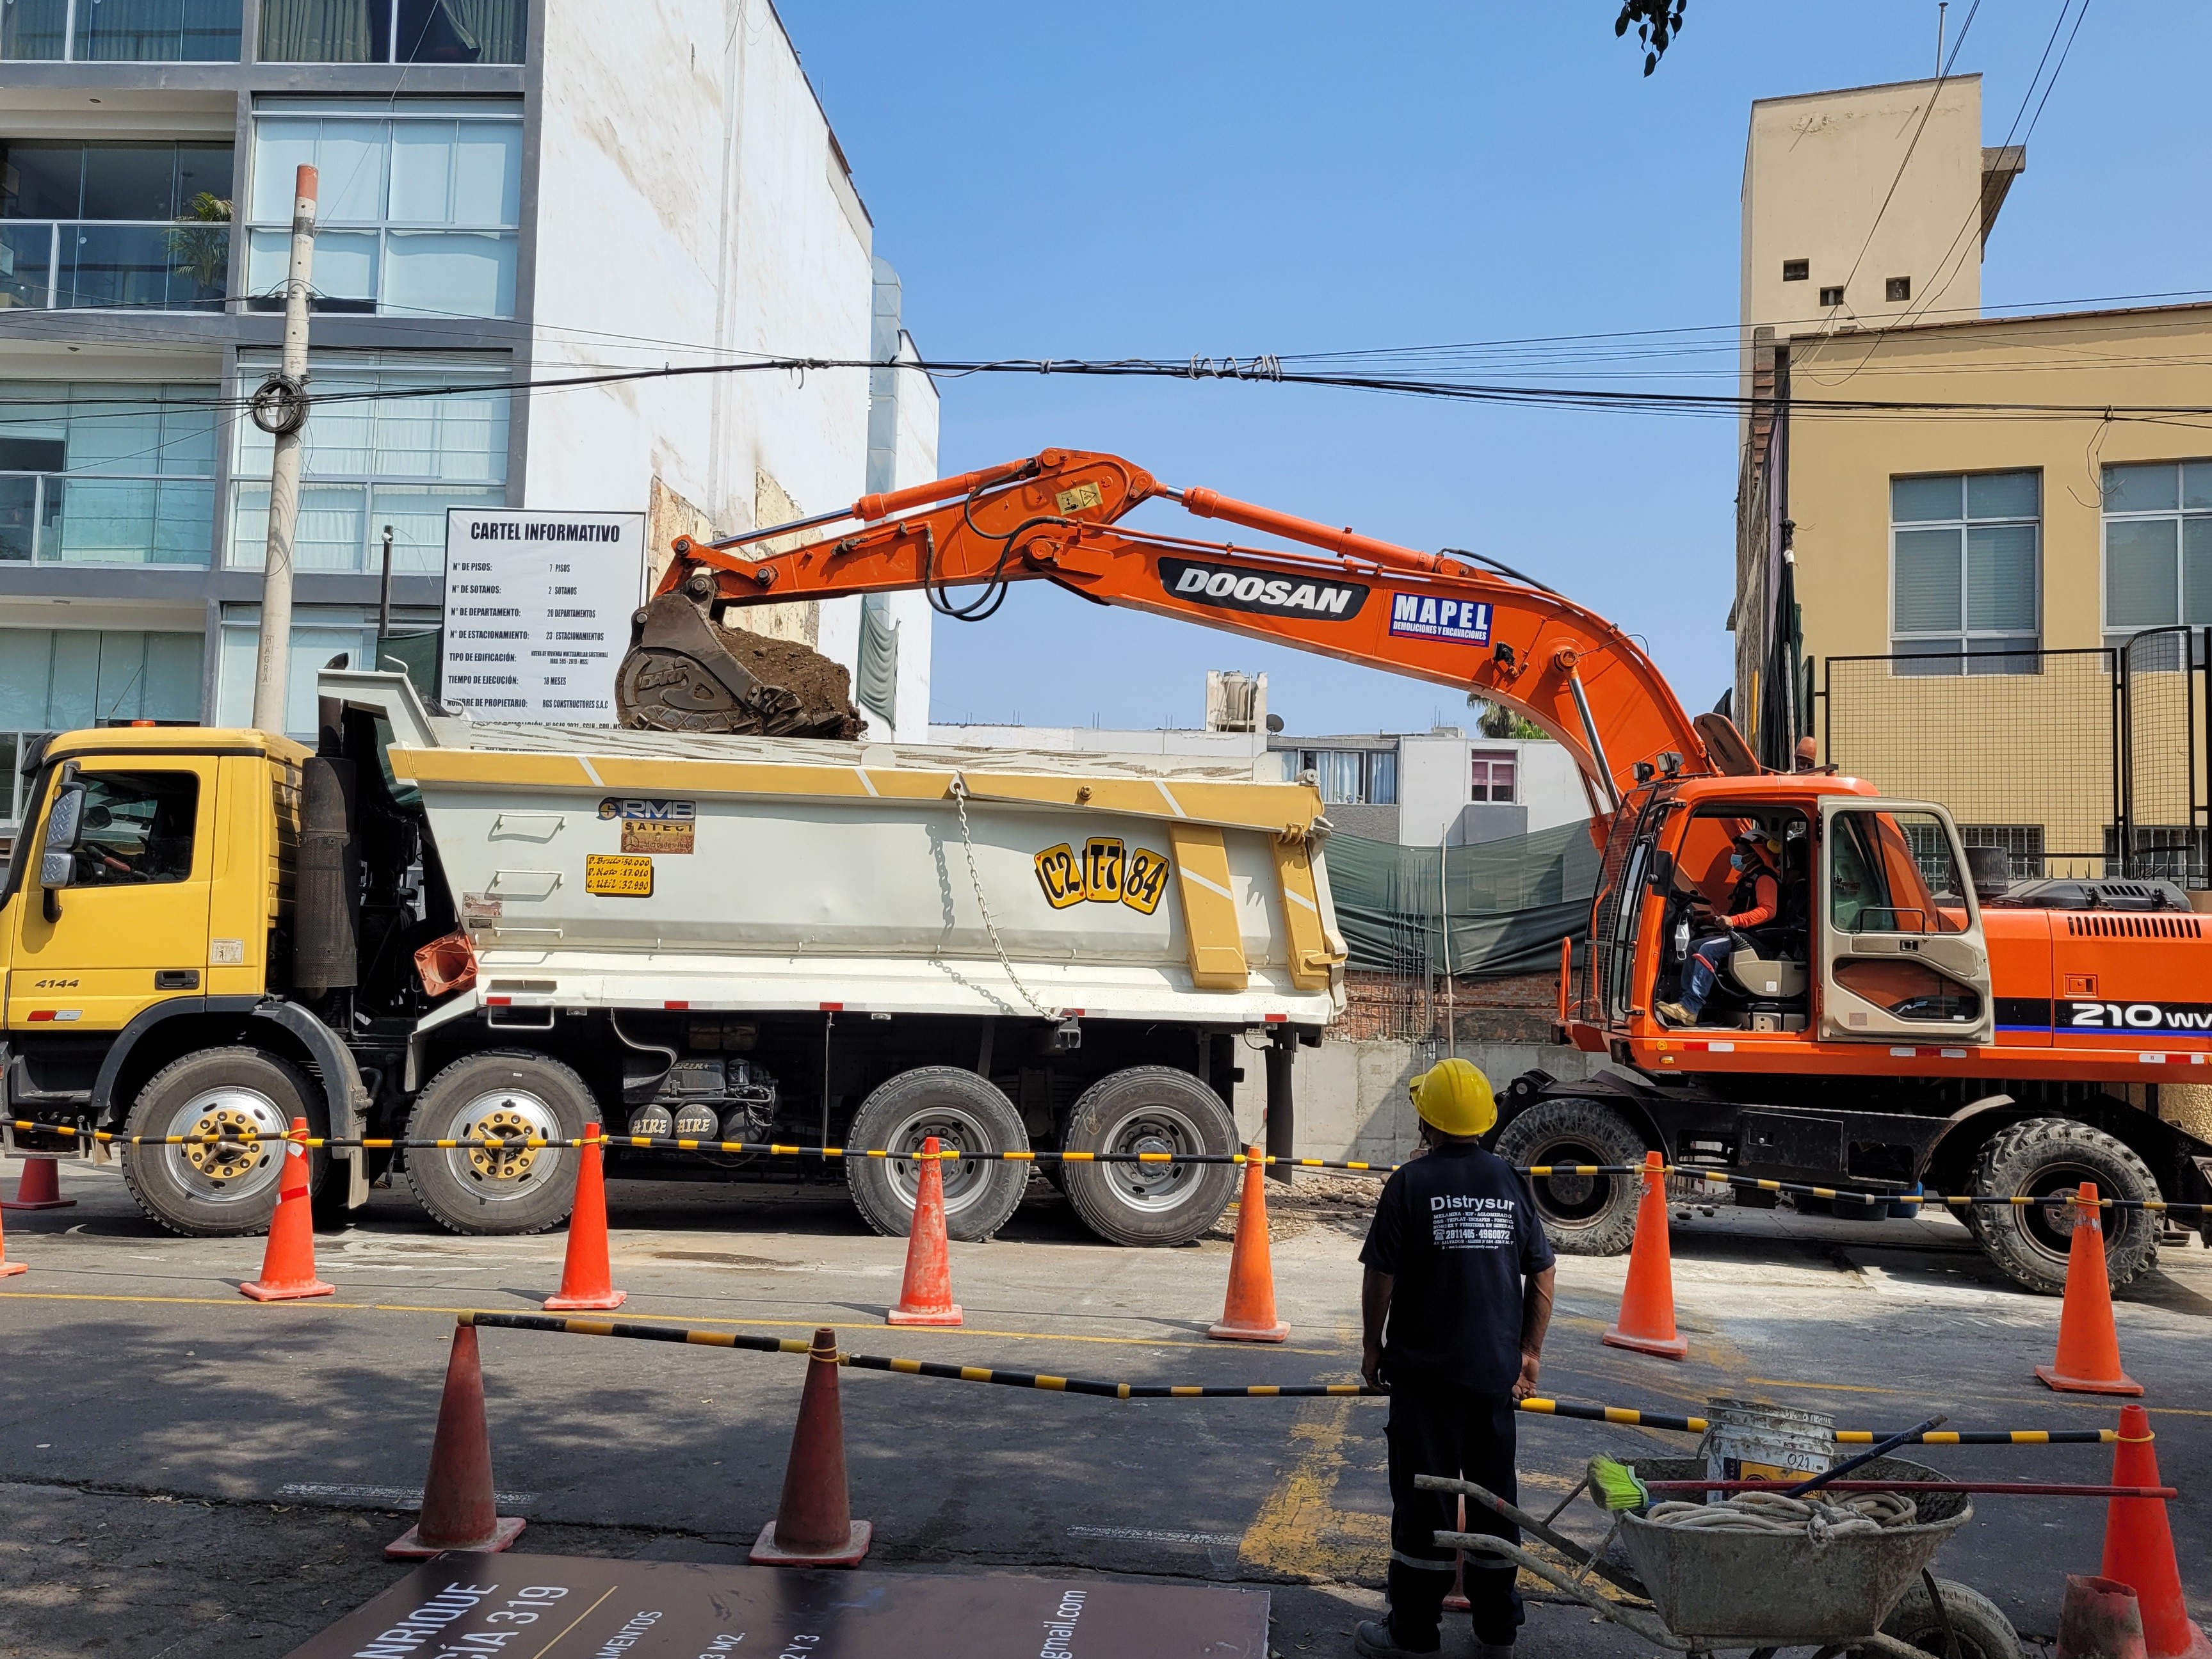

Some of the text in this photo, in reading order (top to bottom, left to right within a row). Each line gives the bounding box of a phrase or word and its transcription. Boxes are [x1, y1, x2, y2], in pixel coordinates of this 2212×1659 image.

[471, 522, 620, 543] CARTEL INFORMATIVO
[462, 562, 470, 571] DE
[471, 562, 493, 572] PISOS:
[549, 563, 570, 573] 7 PISOS
[460, 585, 469, 594] DE
[469, 585, 502, 594] SOTANOS:
[548, 586, 577, 595] 2 SOTANOS
[1175, 567, 1352, 613] DOOSAN
[459, 607, 468, 616] DE
[469, 607, 521, 617] DEPARTAMENTO:
[547, 608, 596, 619] 20 DEPARTAMENTOS
[1394, 594, 1488, 630] MAPEL
[458, 630, 467, 639] DE
[467, 630, 529, 640] ESTACIONAMIENTO:
[1393, 620, 1487, 640] DEMOLICIONES Y EXCAVACIONES
[545, 631, 604, 642] 23 ESTACIONAMIENTOS
[449, 652, 517, 663] TIPO DE EDIFICACIÓN:
[448, 675, 519, 685] TIEMPO DE EJECUCIÓN:
[544, 677, 567, 686] 18 MESES
[474, 698, 483, 707] DE
[484, 698, 528, 708] PROPIETARIO:
[553, 699, 595, 709] CONSTRUCTORES
[622, 800, 695, 819] RMB
[35, 980, 79, 988] 4144
[1430, 1194, 1515, 1211] Distrysur
[433, 1586, 569, 1659] ÍA 319
[1040, 1590, 1087, 1659] gmail.com
[593, 1611, 663, 1659] MENTOS
